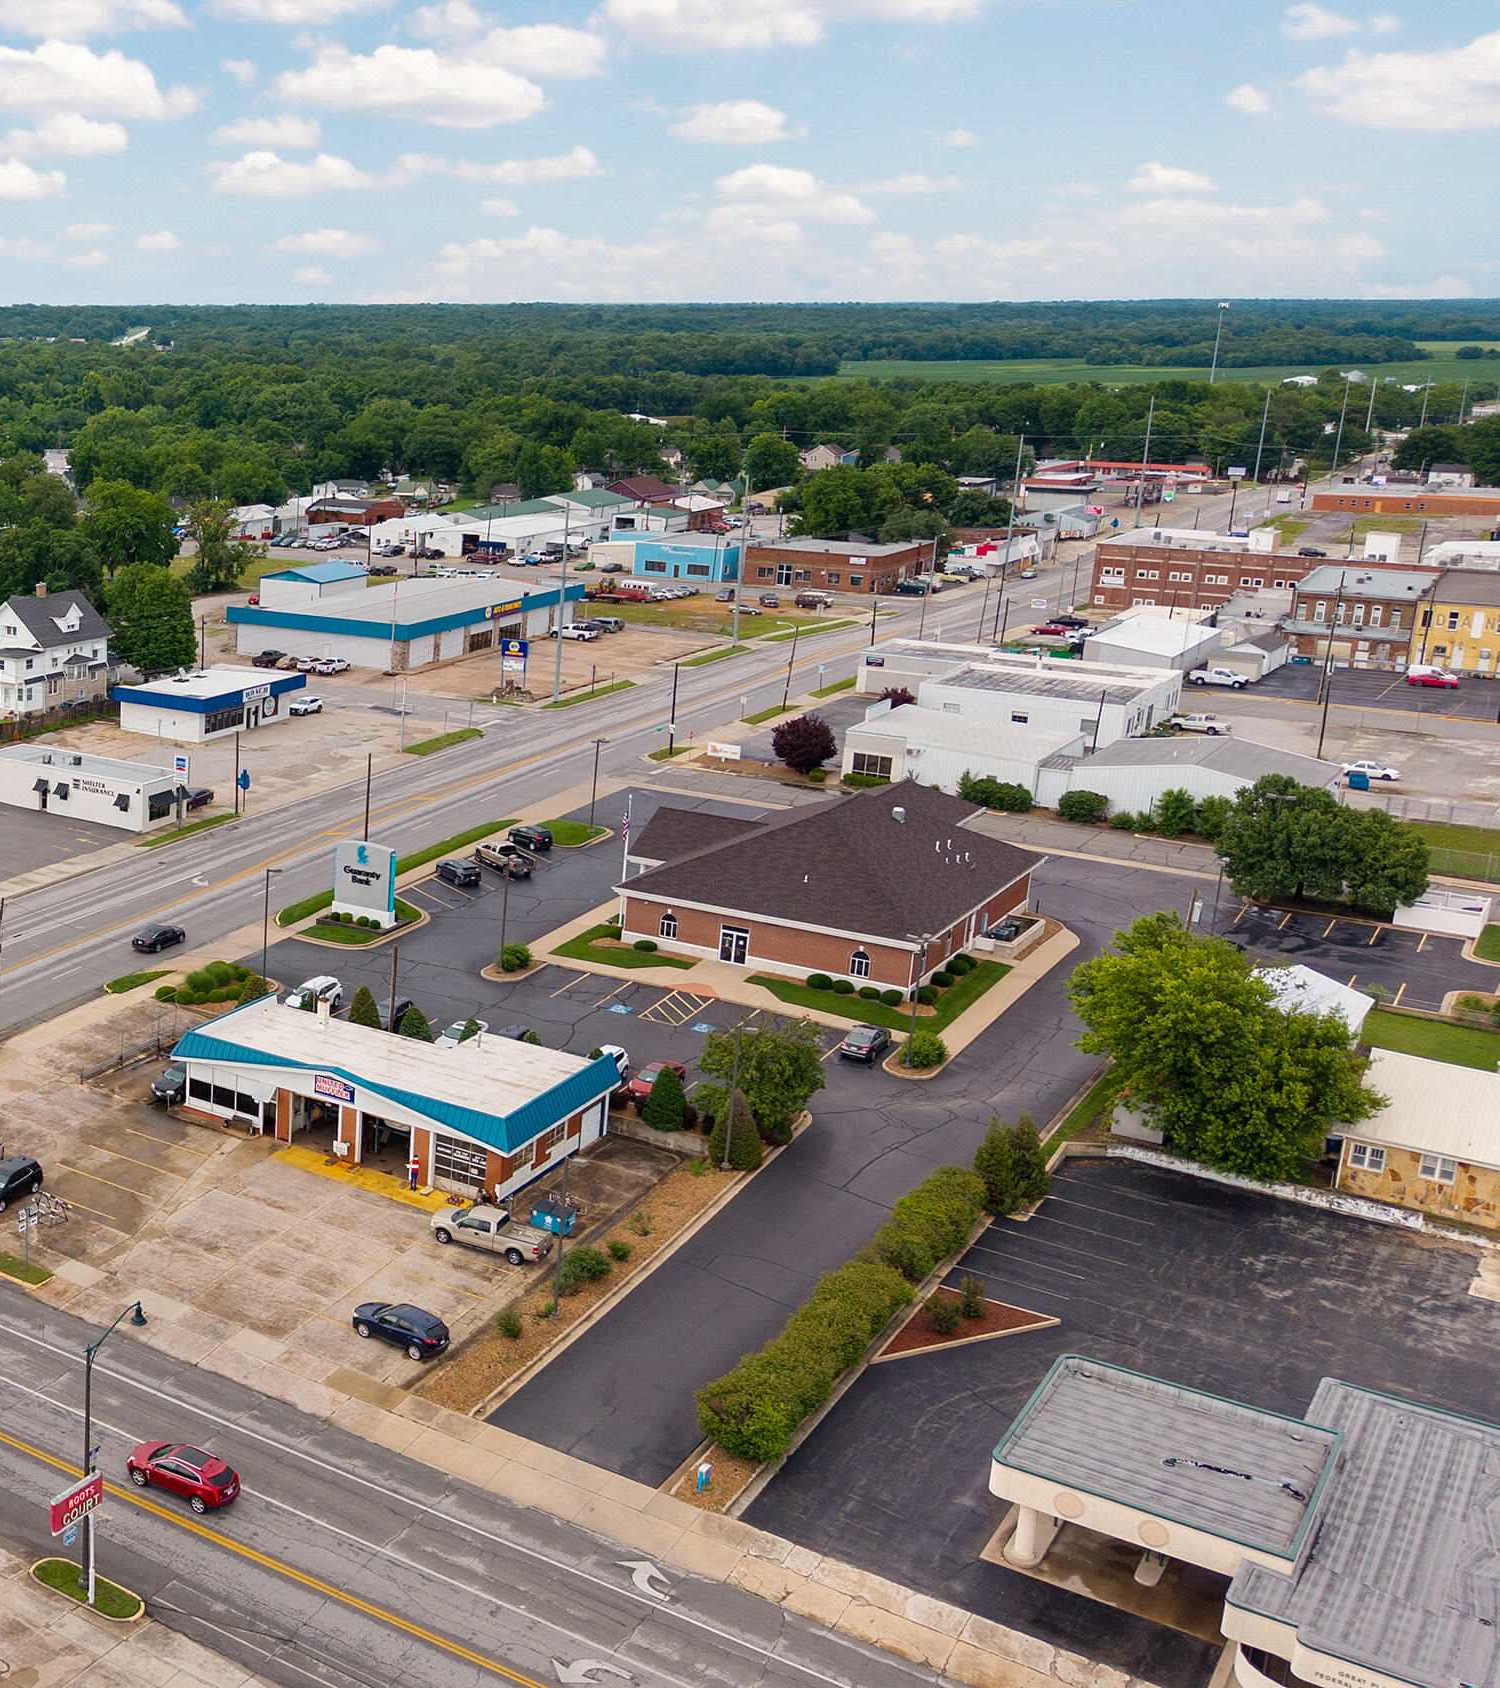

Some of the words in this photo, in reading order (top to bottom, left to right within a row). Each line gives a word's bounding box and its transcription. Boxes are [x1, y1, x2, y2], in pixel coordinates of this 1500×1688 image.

[82, 779, 106, 789] SHELTER
[82, 785, 115, 797] INSURANCE
[343, 865, 381, 881] Guaranty
[351, 875, 372, 887] Bank
[317, 1076, 345, 1090] UNITED
[316, 1084, 351, 1100] MUFFLER
[68, 1485, 96, 1509] BOOTS
[62, 1493, 101, 1526] COURT
[1314, 1671, 1353, 1688] FEDERAL
[1338, 1671, 1366, 1684] GREAT
